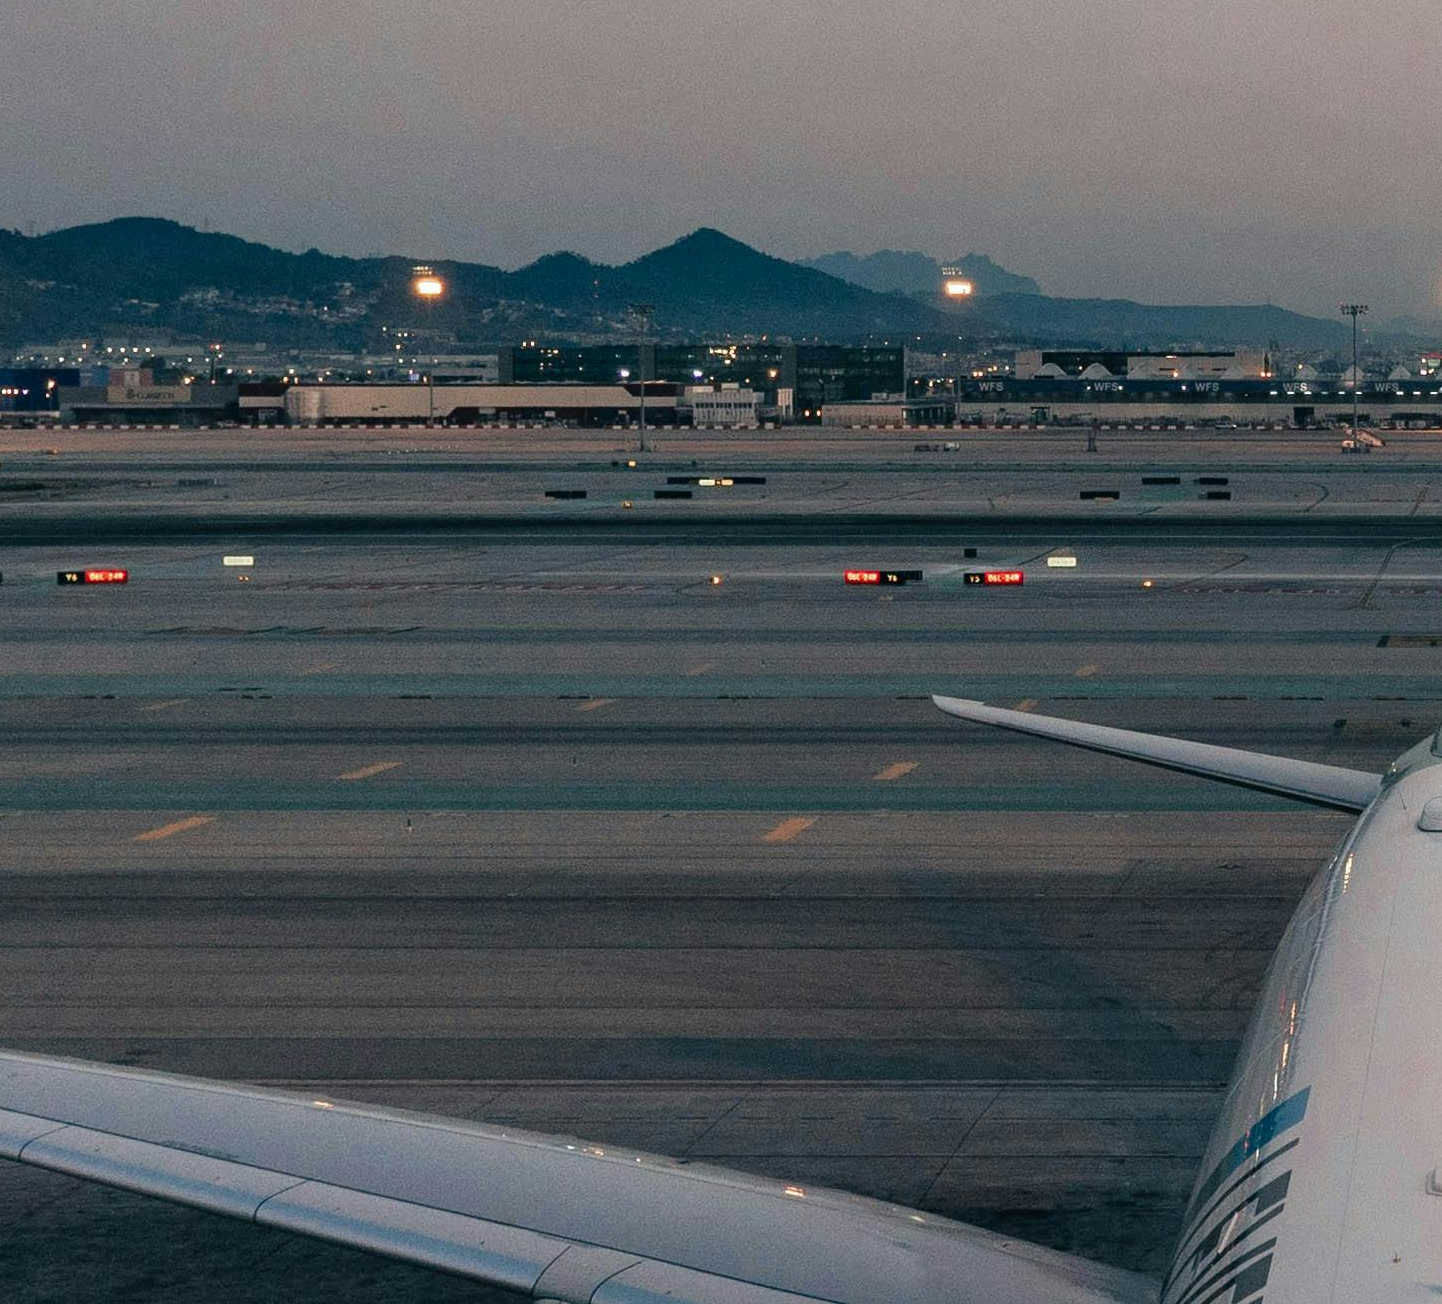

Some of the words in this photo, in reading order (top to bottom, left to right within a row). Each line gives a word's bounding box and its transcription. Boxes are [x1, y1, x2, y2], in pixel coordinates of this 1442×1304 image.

[979, 382, 1004, 391] WFS
[1094, 382, 1119, 391] WFS
[1195, 382, 1220, 391] WFS
[1283, 383, 1308, 392] WFS
[1375, 383, 1400, 392] WFS
